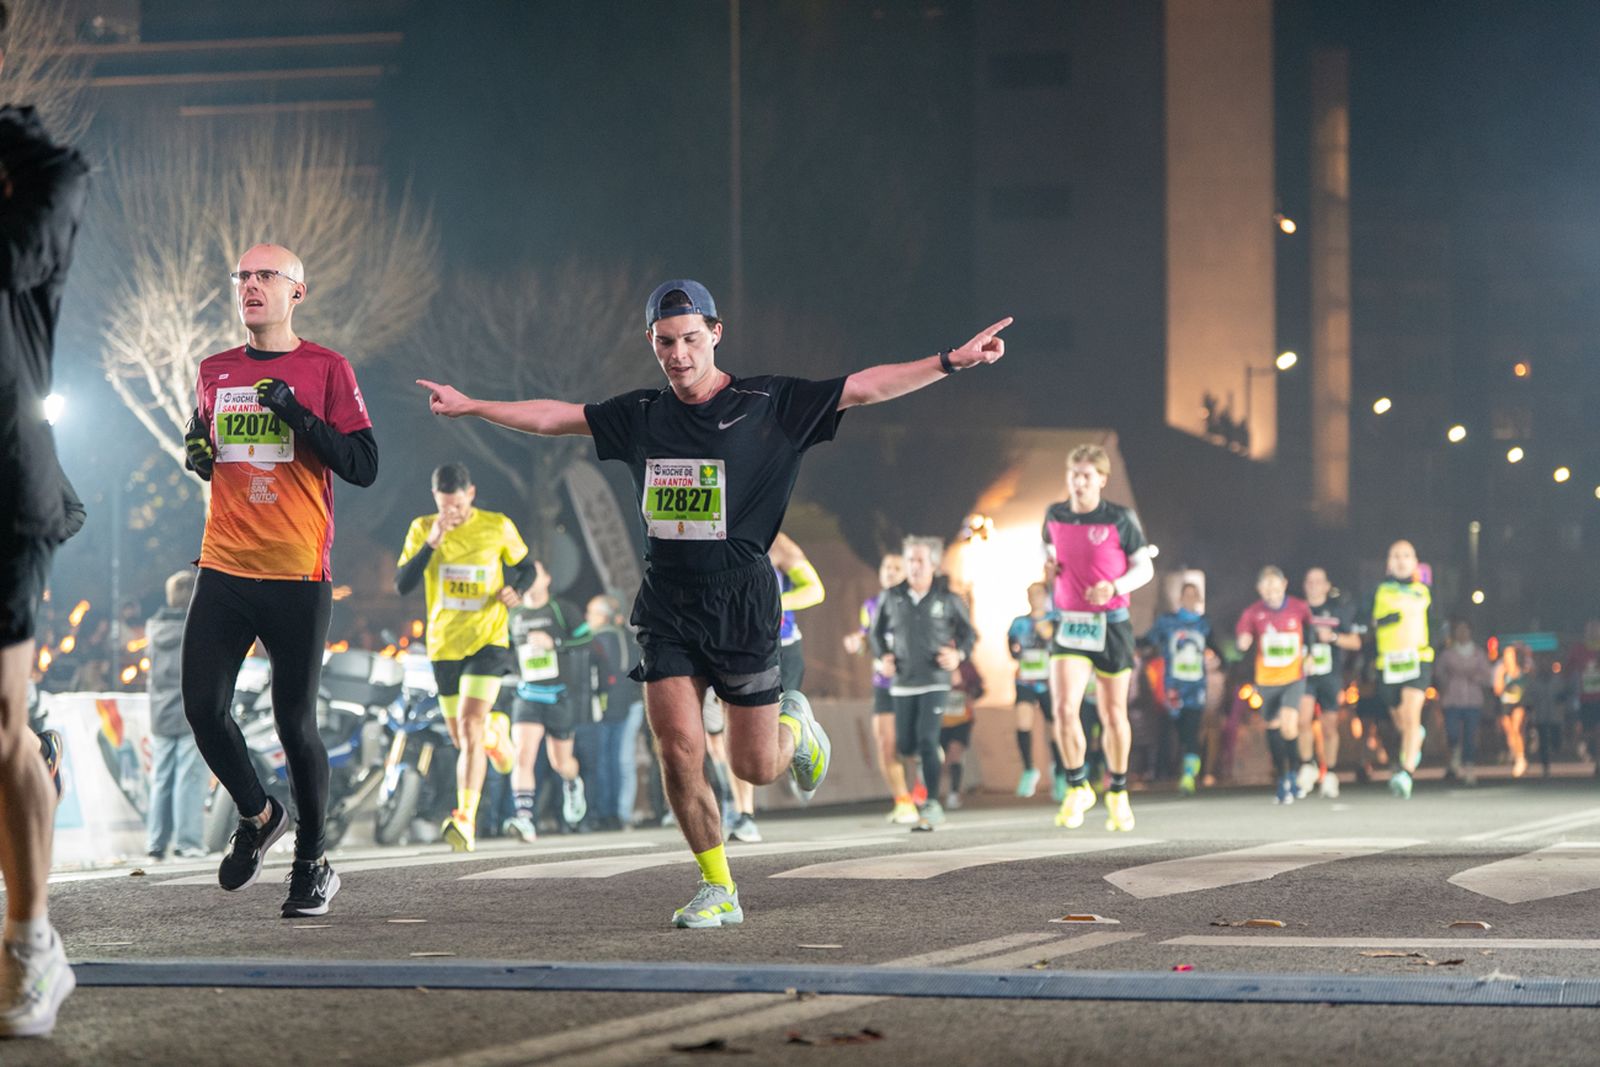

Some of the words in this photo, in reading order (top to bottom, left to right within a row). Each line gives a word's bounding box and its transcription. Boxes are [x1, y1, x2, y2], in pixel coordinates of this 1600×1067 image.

[222, 404, 237, 413] SAN
[224, 414, 281, 436] 12074
[661, 468, 683, 476] NOCHE
[684, 468, 693, 476] DE
[653, 478, 667, 487] SAN
[655, 487, 712, 512] 12827
